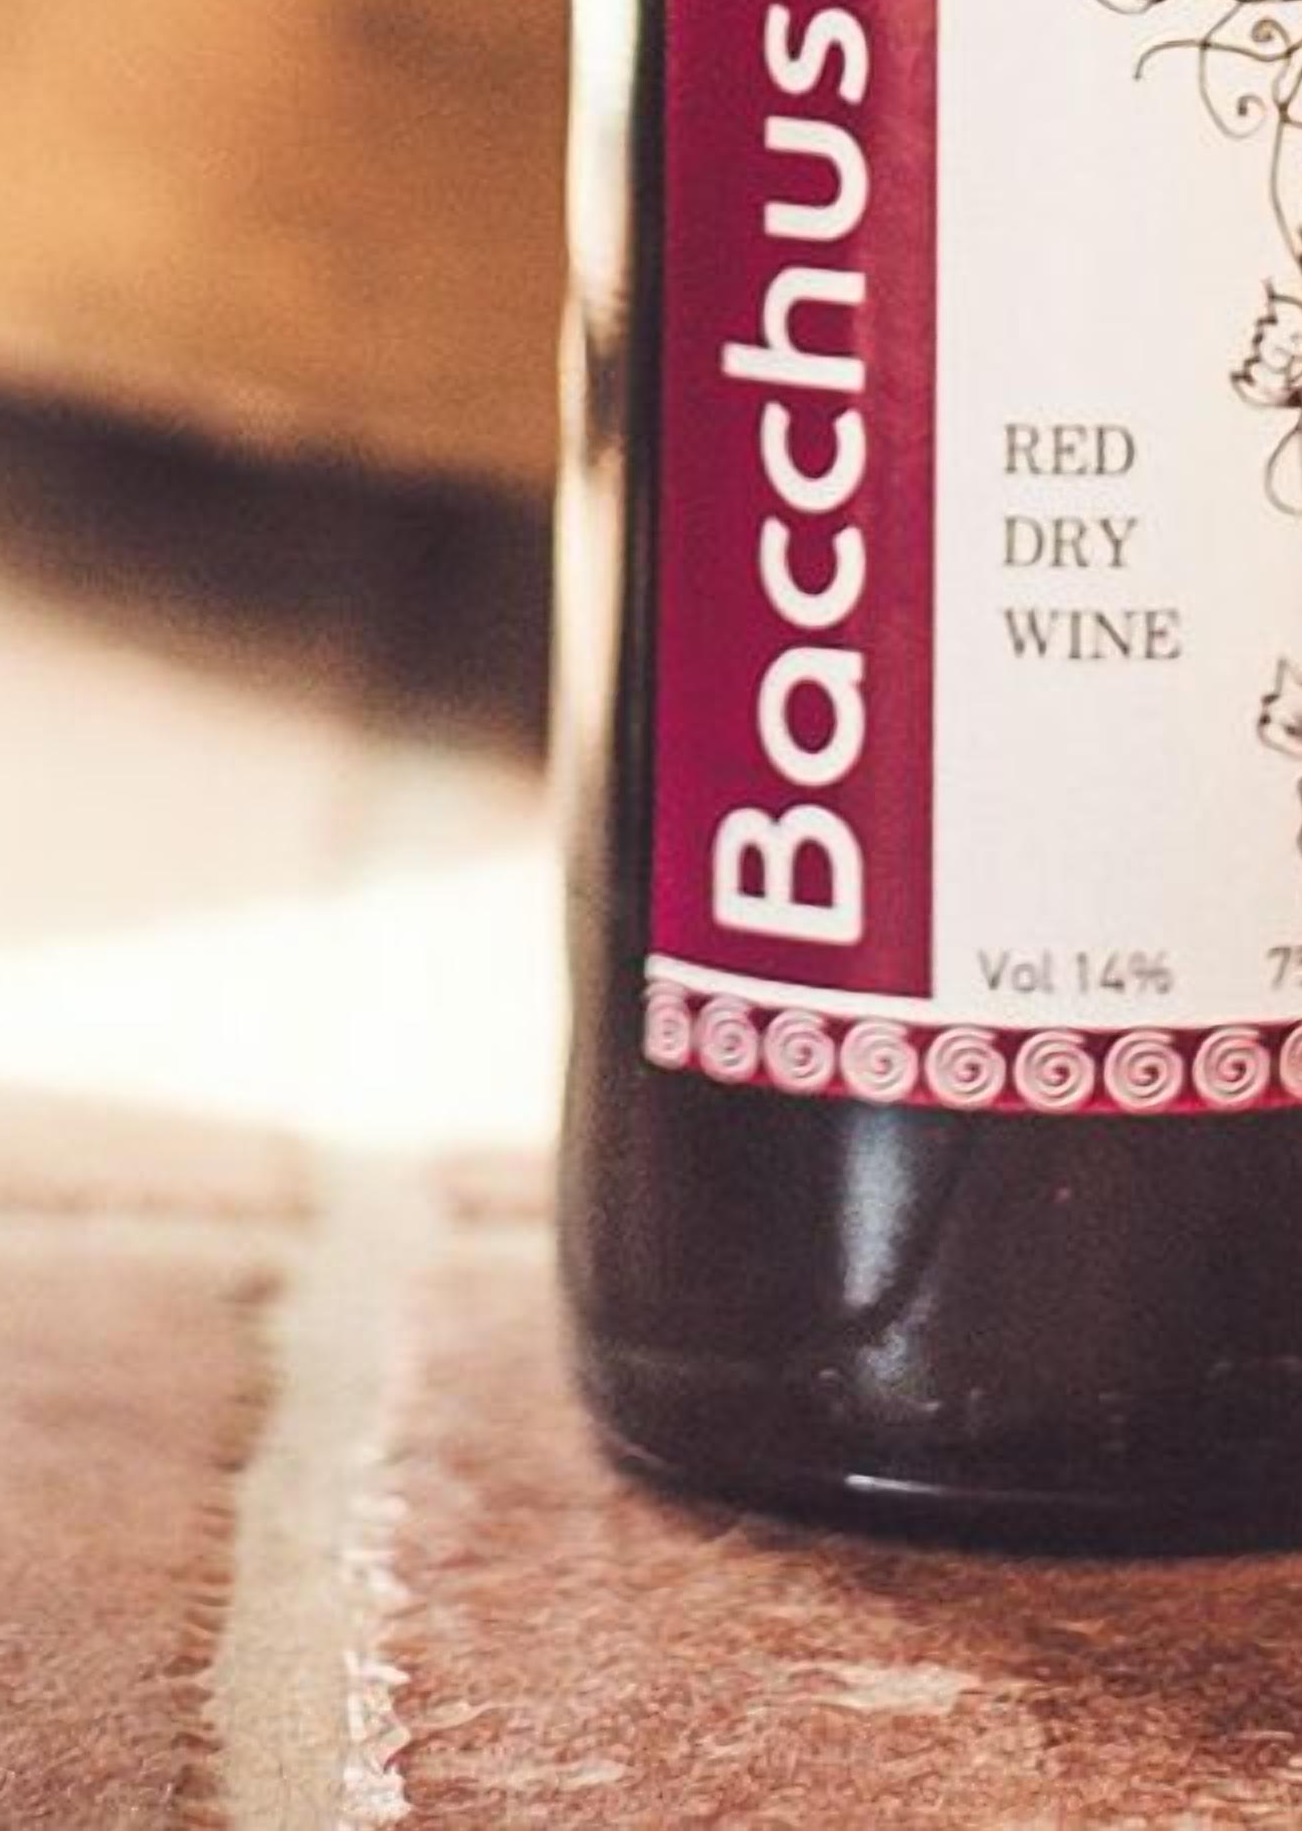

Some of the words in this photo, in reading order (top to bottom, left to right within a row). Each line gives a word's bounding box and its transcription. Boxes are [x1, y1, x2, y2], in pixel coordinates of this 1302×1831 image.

[714, 3, 869, 944] Bacchus
[1004, 423, 1137, 476] RED
[1004, 516, 1137, 568] DRY
[1002, 608, 1181, 660] WINE
[1074, 950, 1175, 996] 14%
